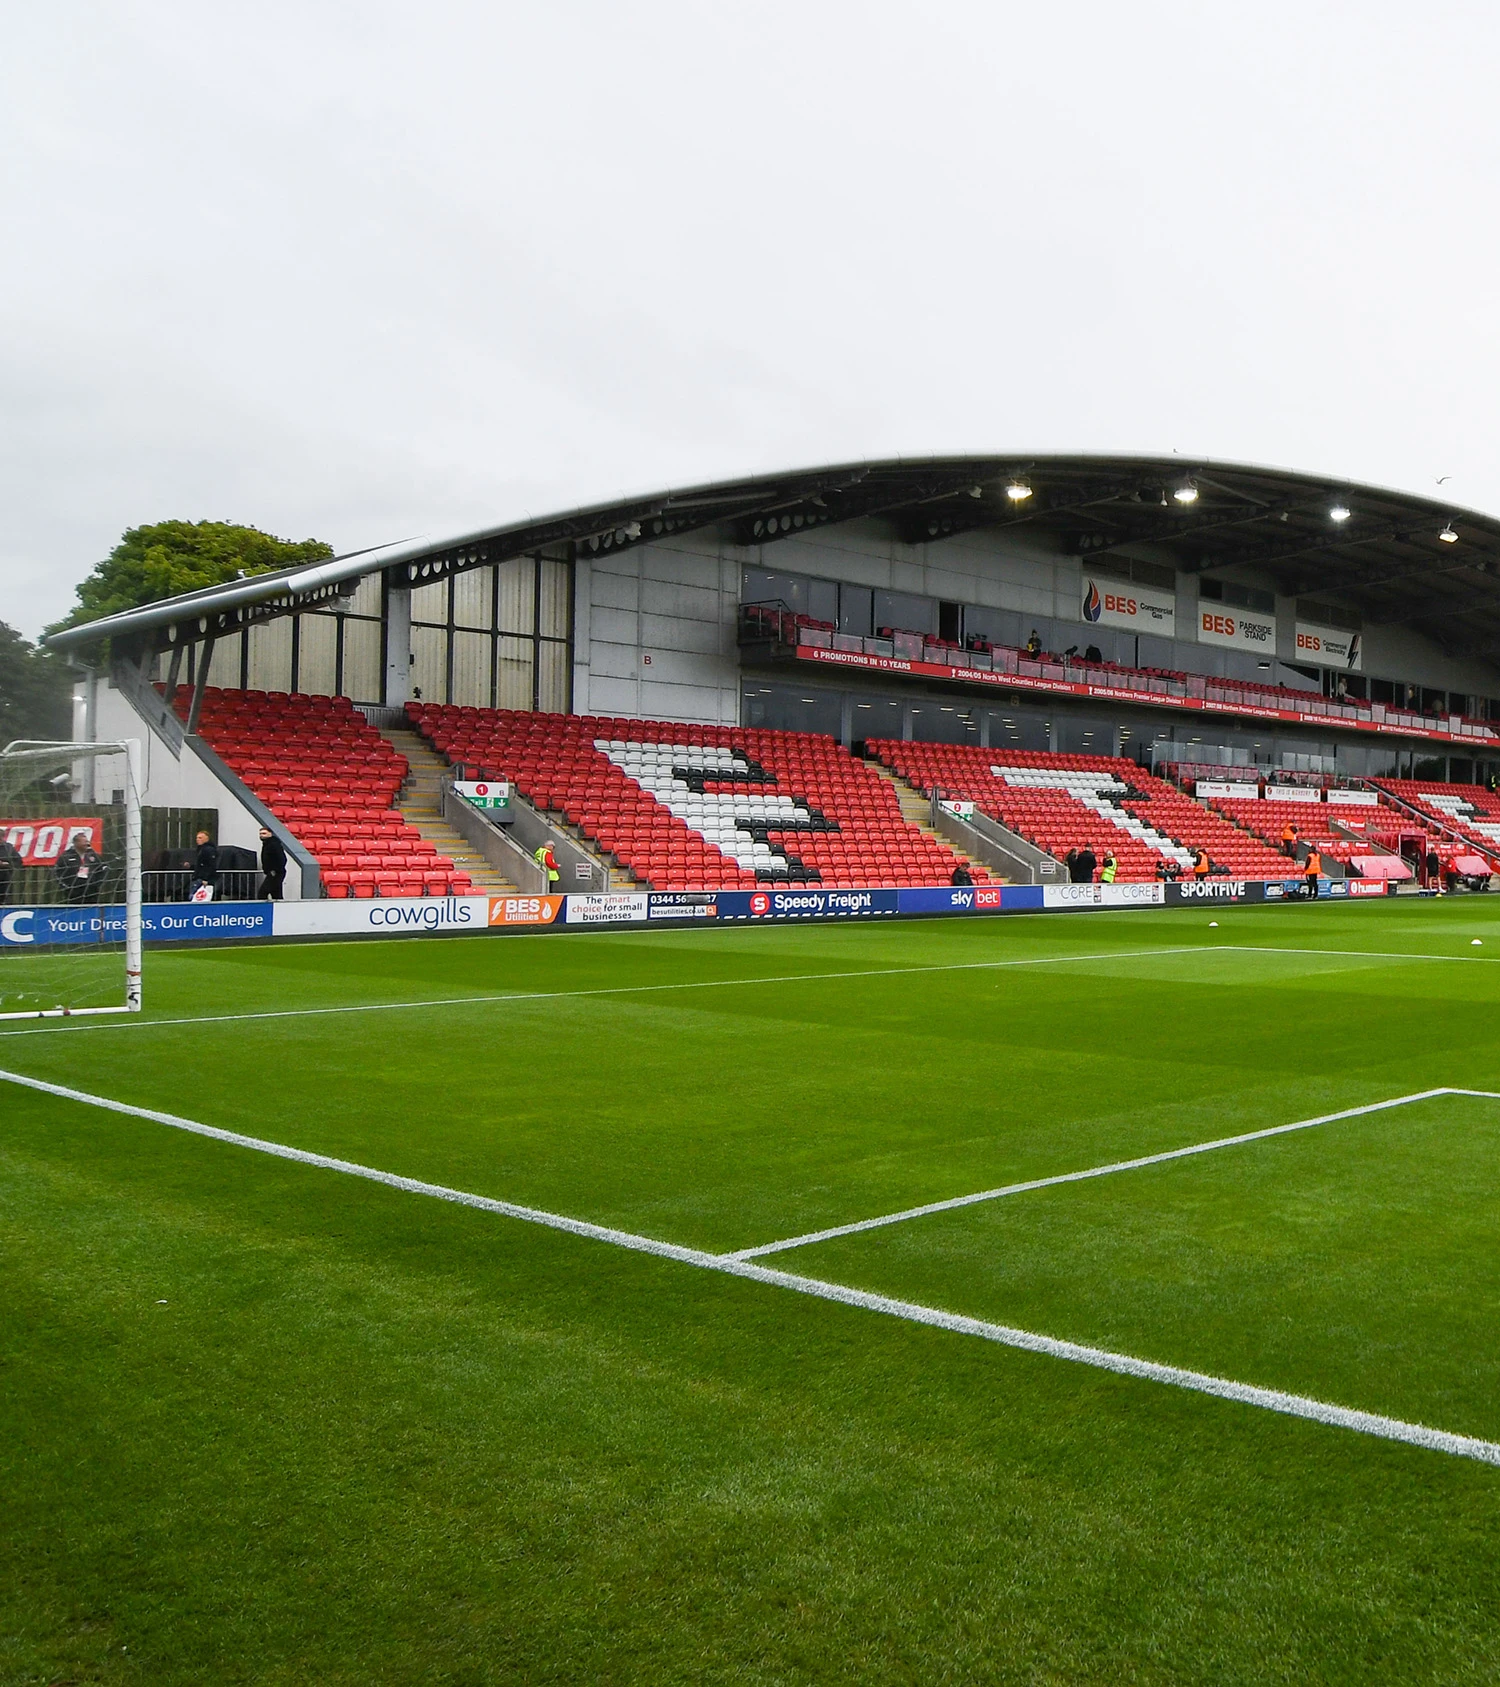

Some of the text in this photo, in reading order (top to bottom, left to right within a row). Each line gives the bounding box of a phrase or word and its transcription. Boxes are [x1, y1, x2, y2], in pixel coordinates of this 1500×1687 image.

[1105, 594, 1137, 615] BES
[1140, 602, 1173, 615] Commercial
[1152, 611, 1162, 619] Gas
[1203, 613, 1235, 636] BES
[1239, 621, 1272, 636] PARKSIDE
[1245, 630, 1266, 642] STAND
[1297, 634, 1320, 651] BES
[644, 656, 652, 664] B
[814, 650, 818, 658] 6
[820, 651, 868, 665] PROMOTIONS
[879, 659, 887, 667] 10
[889, 661, 911, 670] YEARS
[958, 670, 981, 679] 2004/05
[983, 673, 997, 682] North
[1012, 677, 1033, 686] Counties
[1034, 680, 1051, 690] League
[1053, 682, 1071, 691] Division
[1115, 690, 1133, 699] Northern
[1150, 695, 1165, 703] League
[1180, 882, 1246, 898] SPORTFIVE
[505, 898, 540, 913] BES
[585, 896, 603, 904] The
[651, 895, 674, 904] 0344
[774, 893, 825, 912] Speedy
[828, 892, 871, 909] Freight
[951, 890, 998, 908] sky bet
[369, 898, 471, 930] cowgills
[572, 903, 643, 914] choice for small
[48, 919, 86, 932] Your
[161, 917, 189, 929] Our
[193, 914, 264, 932] Challenge
[505, 913, 539, 921] Utilities
[582, 912, 632, 921] businesses
